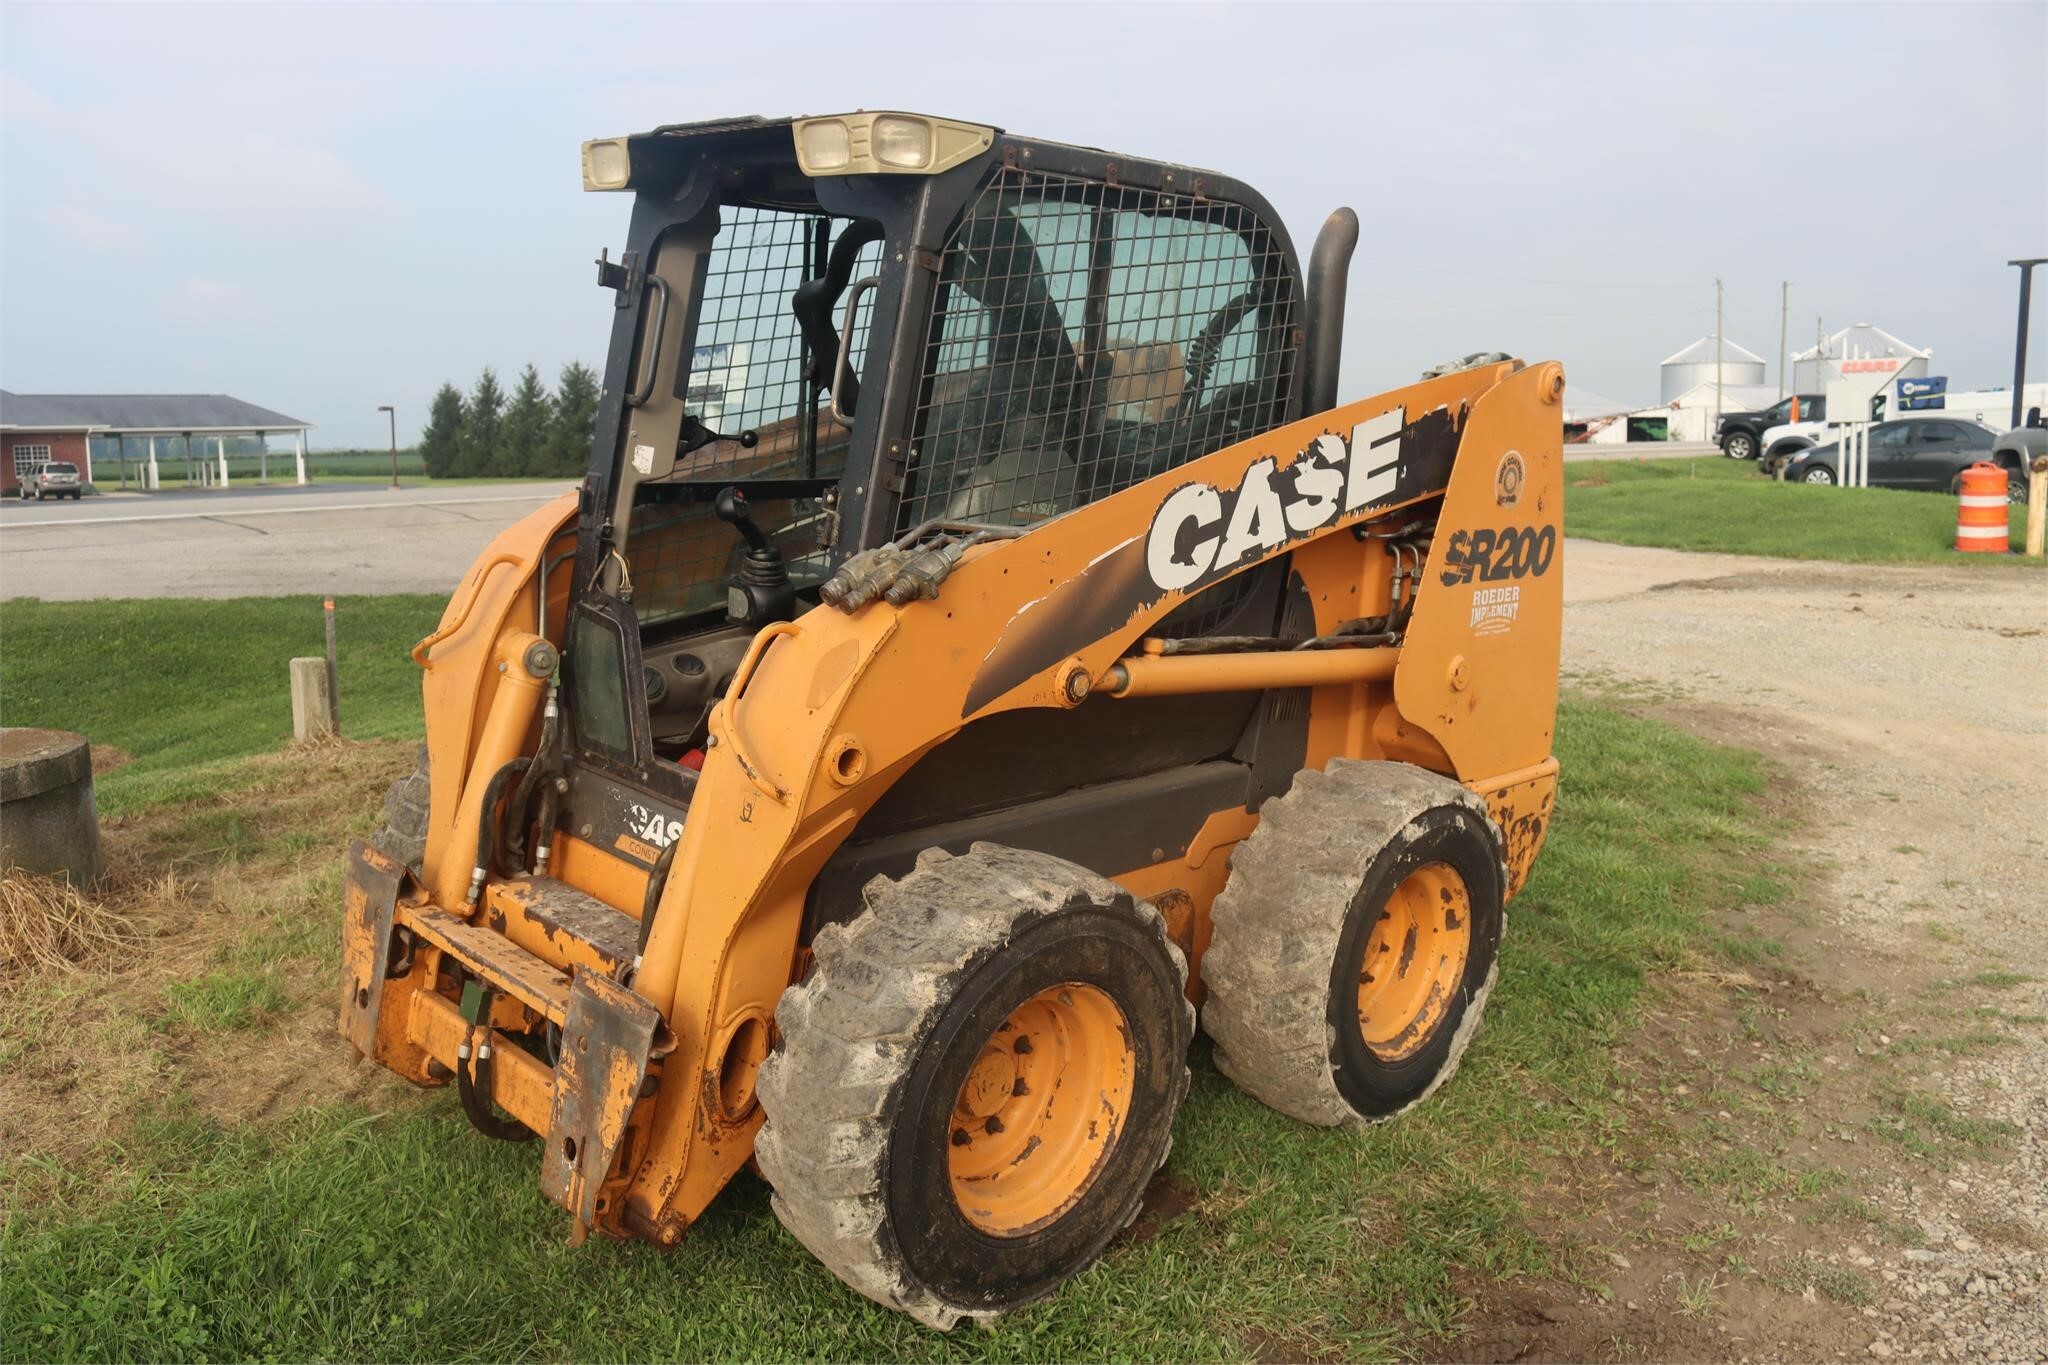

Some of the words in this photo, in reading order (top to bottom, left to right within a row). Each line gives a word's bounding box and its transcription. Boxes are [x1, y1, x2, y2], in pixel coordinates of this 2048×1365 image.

[1147, 408, 1403, 590] CASE
[1440, 524, 1556, 587] SR200
[1473, 586, 1520, 606] ROEDER
[1470, 602, 1519, 627] IMPLEMENT
[628, 841, 660, 861] CONST
